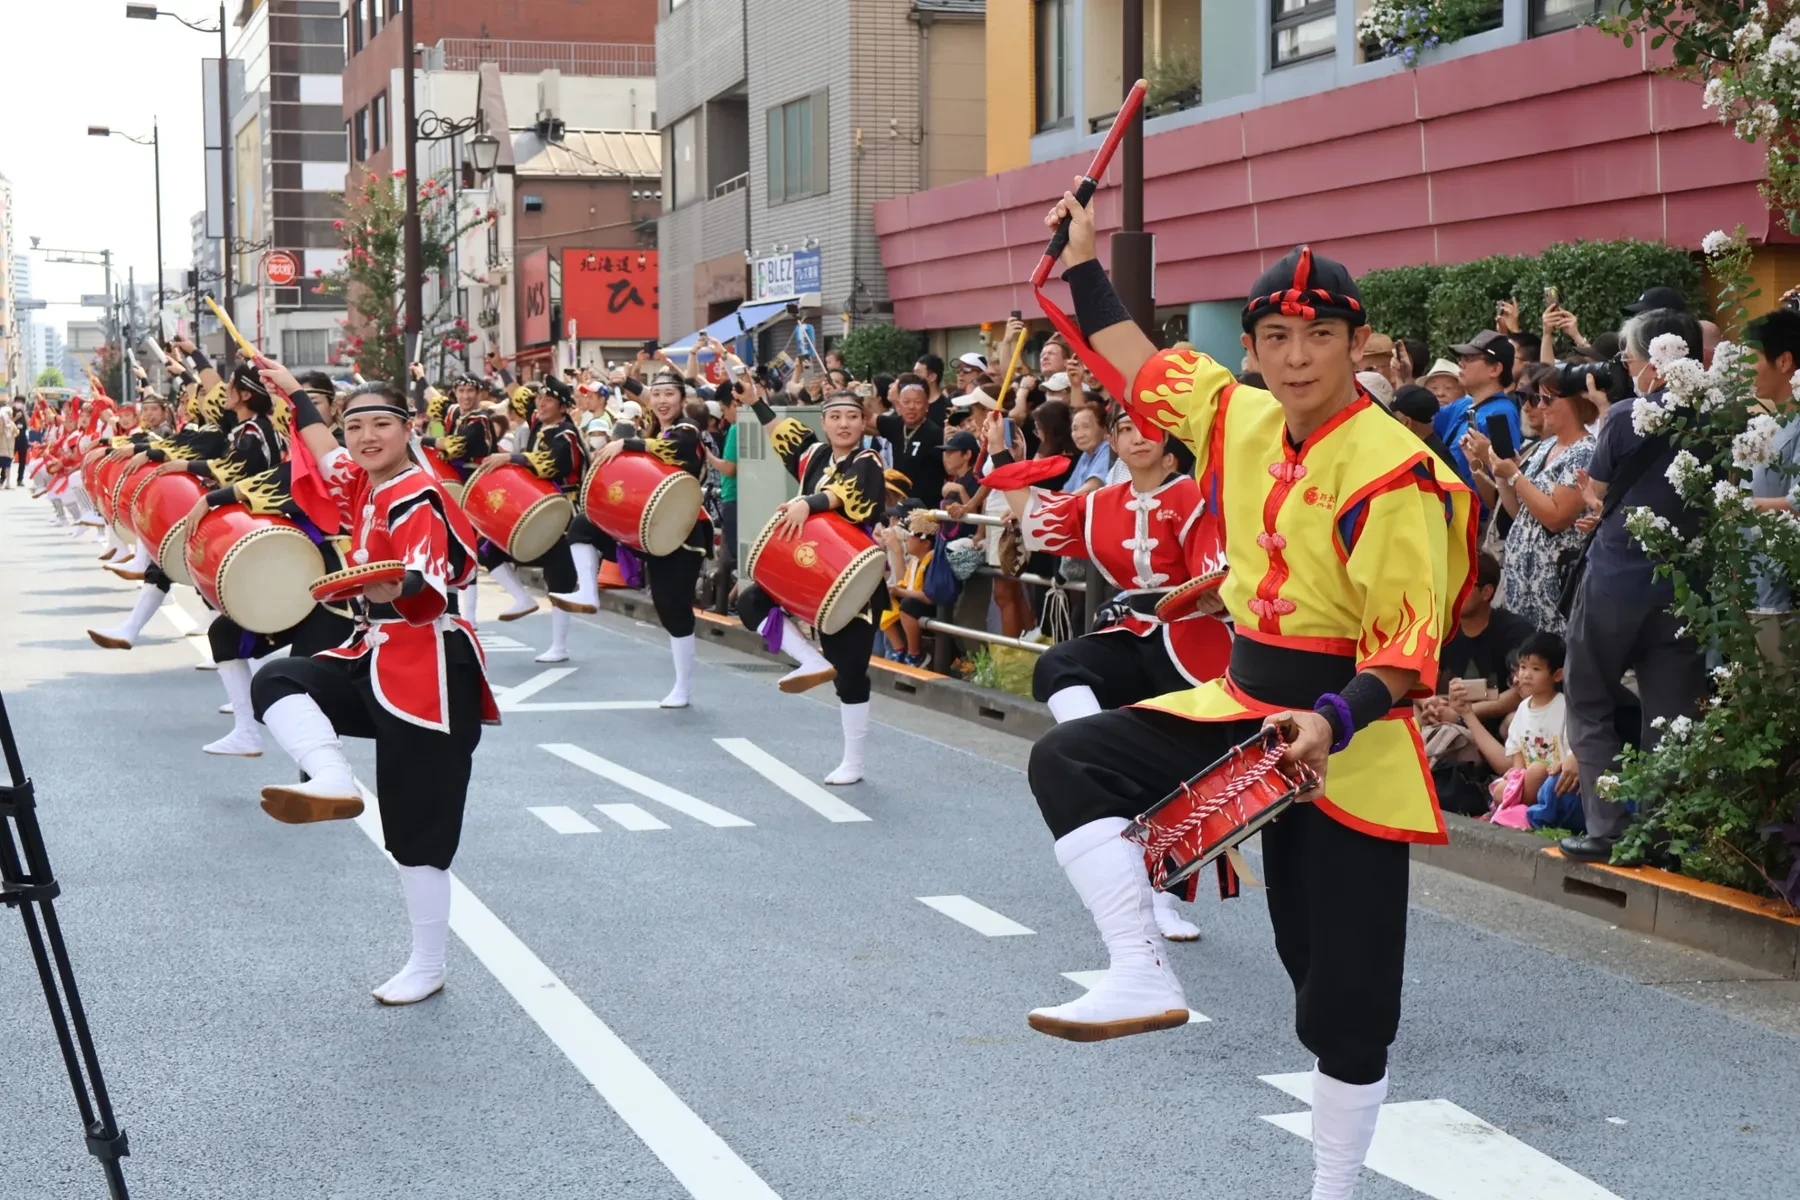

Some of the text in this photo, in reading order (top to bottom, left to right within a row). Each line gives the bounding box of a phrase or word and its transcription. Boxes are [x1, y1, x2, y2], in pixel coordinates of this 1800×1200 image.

[267, 264, 292, 275] 消火栓
[767, 258, 792, 283] BLEZ
[911, 441, 921, 457] 7
